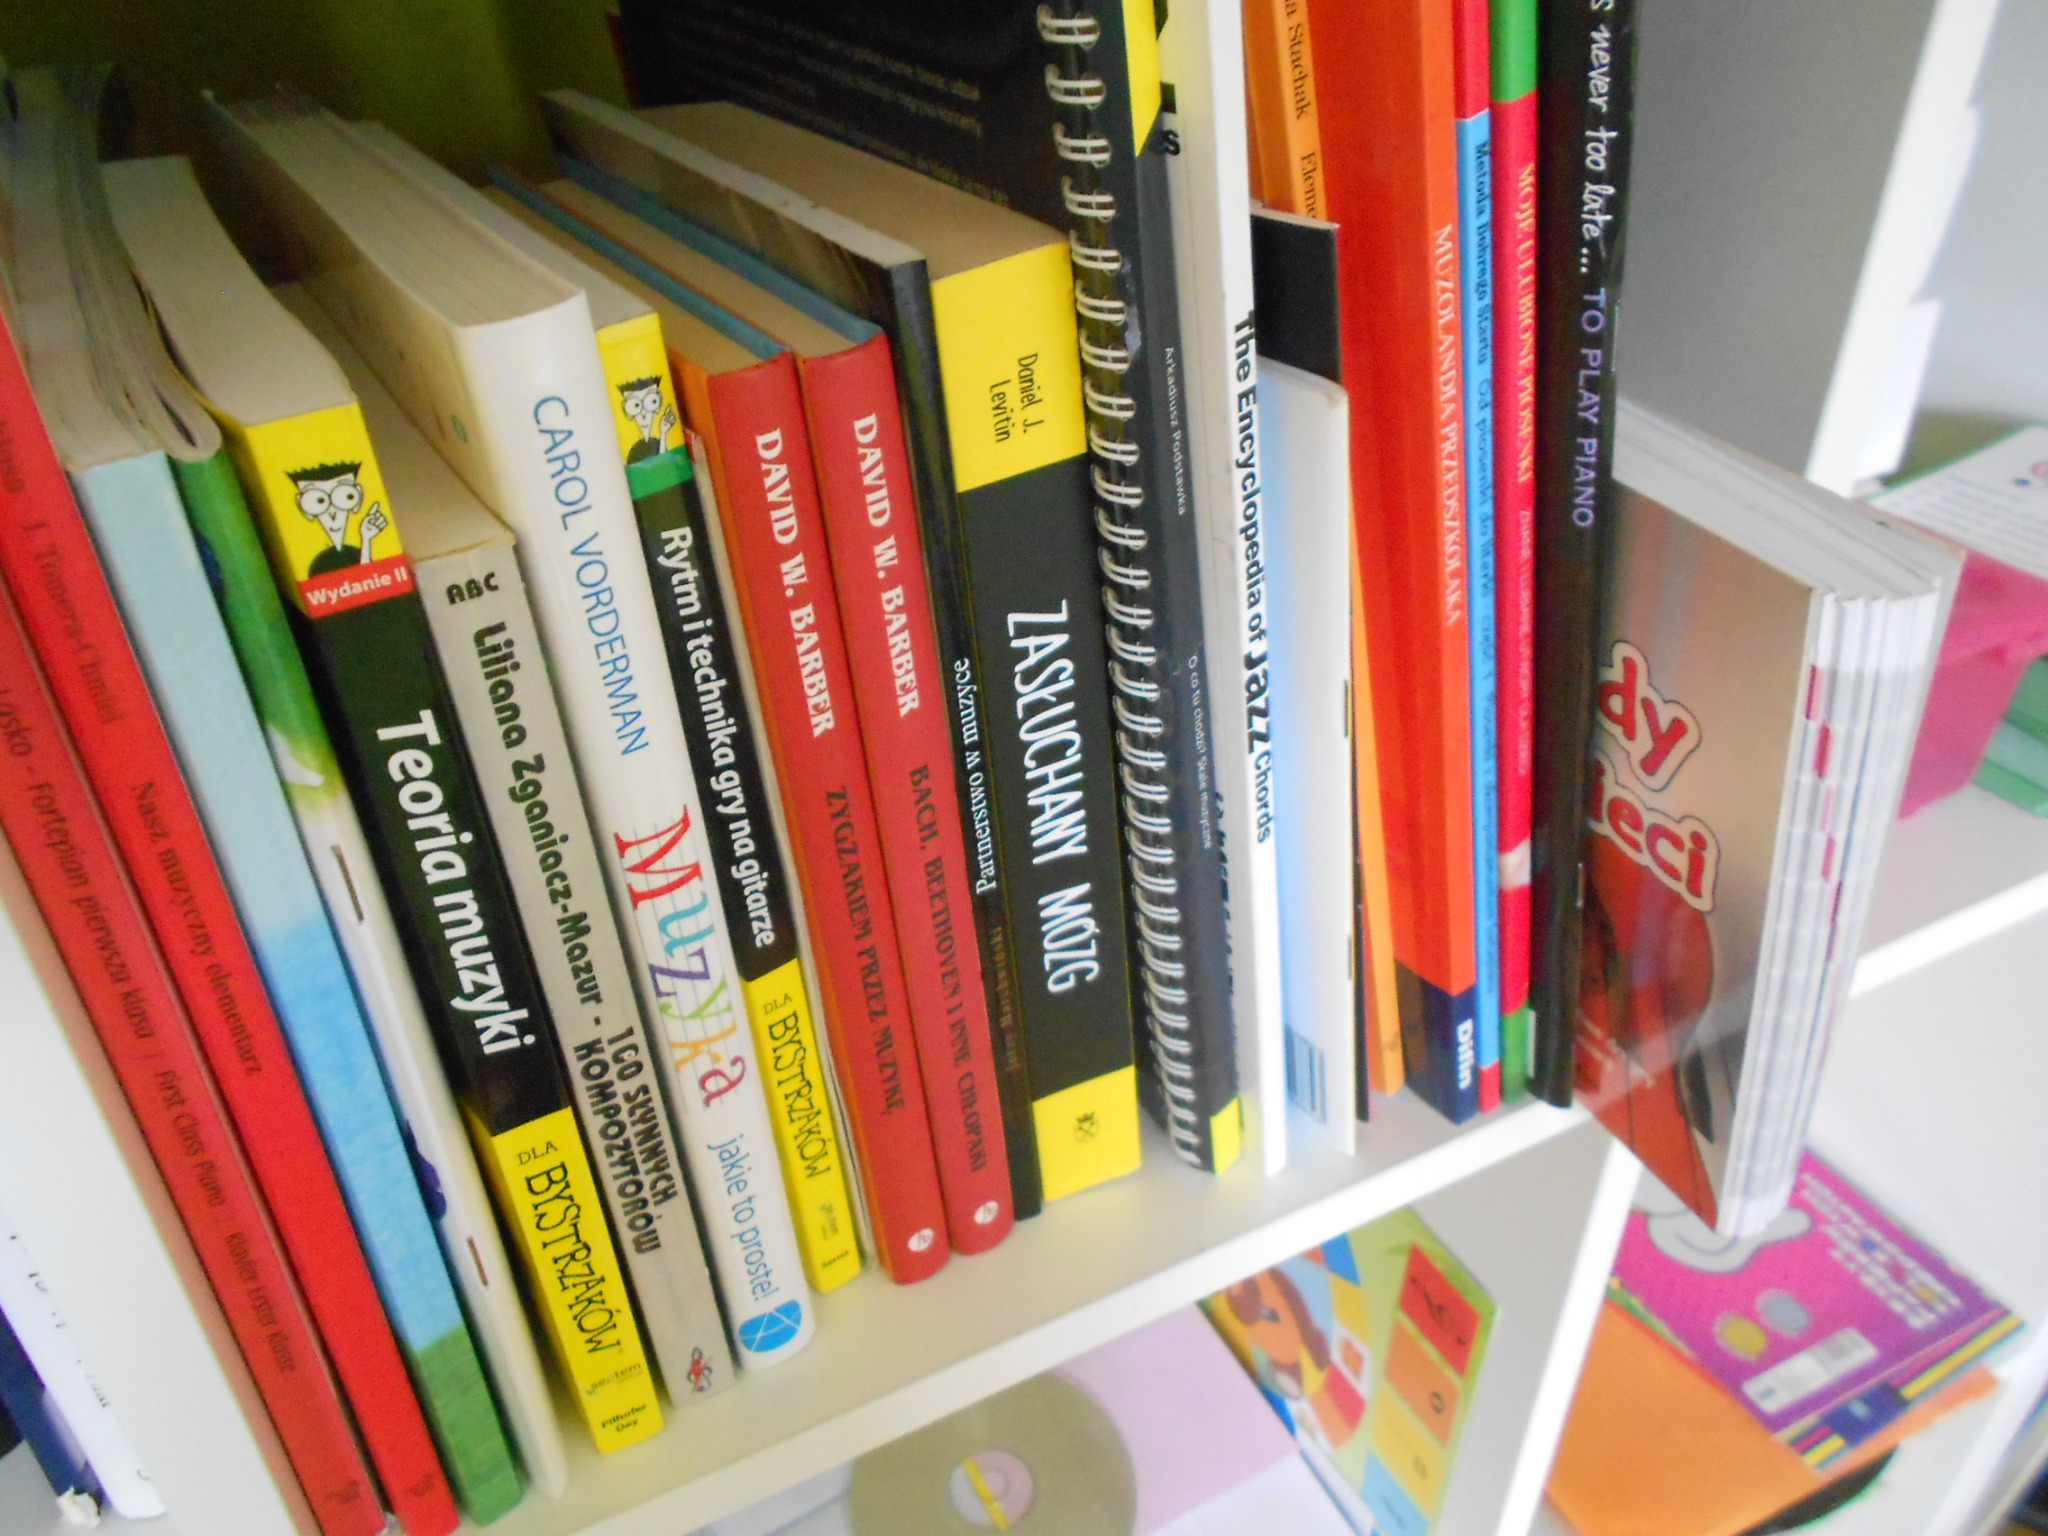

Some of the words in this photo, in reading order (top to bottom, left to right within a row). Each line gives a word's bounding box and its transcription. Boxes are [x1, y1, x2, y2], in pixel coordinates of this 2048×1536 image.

[1289, 23, 1309, 119] Stachak
[1588, 24, 1611, 112] never
[1475, 140, 1490, 219] Metoda
[1585, 126, 1618, 171] too
[1515, 164, 1534, 233] MOJE
[1474, 221, 1490, 301] Dobrego
[1517, 236, 1535, 371] ULUBIONE
[1234, 311, 1258, 382] The
[1435, 225, 1456, 420] MUZOLANDIA
[1581, 287, 1606, 332] TO
[990, 380, 1014, 442] Levitin
[1018, 353, 1042, 410] Daniel
[1578, 349, 1602, 424] PLAY
[1023, 419, 1044, 433] J.
[1165, 347, 1178, 427] Arkadiusz
[1173, 430, 1186, 515] Podstawka
[1517, 373, 1535, 484] PIOSENKI
[757, 428, 797, 544] DAVID
[854, 414, 890, 527] DAVID
[1236, 387, 1264, 609] Encyclopedia
[1573, 438, 1597, 527] PIANO
[874, 535, 897, 578] W.
[1441, 422, 1461, 625] PRZEDSZKOLAKA
[306, 571, 390, 607] Wydanie
[446, 572, 499, 605] ABC
[534, 396, 592, 531] CAROL
[571, 532, 649, 755] VORDERMAN
[657, 527, 701, 616] Rytm
[781, 553, 807, 597] W.
[683, 619, 712, 631] i
[882, 585, 919, 716] BARBER
[1189, 656, 1197, 668] O
[1249, 613, 1267, 642] of
[687, 634, 737, 767] technika
[790, 603, 834, 737] BARBER
[954, 658, 978, 745] muzyce
[1191, 672, 1198, 688] co
[1244, 652, 1271, 757] Jazz
[966, 751, 980, 769] w
[1007, 599, 1087, 864] ZASŁUCHANY
[1198, 756, 1208, 790] Skale
[474, 622, 526, 749] Liliana
[509, 754, 603, 1004] Zganiacz-Mazur
[594, 1017, 600, 1025] -
[710, 770, 746, 814] gry
[910, 765, 939, 850] BACH,
[969, 772, 996, 894] Partnerstwo
[1200, 792, 1211, 849] muzyczne
[1255, 753, 1274, 843] Chords
[377, 709, 472, 884] Teoria
[433, 890, 535, 1054] muzyki
[729, 819, 755, 856] na
[131, 782, 169, 843] Nasz
[158, 848, 214, 956] muzyczny
[205, 964, 262, 1076] elementarz
[731, 859, 775, 947] gitarze
[925, 857, 960, 998] BEETHOVEN
[1038, 883, 1100, 992] MÓZG
[27, 782, 90, 888] Fortepian
[70, 894, 131, 983] pierwsza
[120, 989, 155, 1039] klasa
[156, 1070, 187, 1110] First
[173, 1113, 205, 1157] Class
[194, 1160, 225, 1207] Piano
[614, 804, 746, 1106] Muzyka
[826, 788, 872, 940] ZYGZAKIEM
[858, 946, 887, 1018] PRZEZ
[875, 1026, 904, 1114] MUZYKĘ
[763, 994, 792, 1015] DLA
[947, 1003, 963, 1015] I
[950, 1018, 971, 1067] INNE
[768, 1010, 833, 1178] BYSTRZAKÓW
[958, 1072, 986, 1172] CHŁOPAKI
[517, 1140, 558, 1165] DLA
[574, 1038, 661, 1253] KOMPOZYTORÓW
[623, 1084, 677, 1206] SŁYNNYCH
[707, 1134, 751, 1195] jakie
[732, 1196, 755, 1223] to
[525, 1162, 619, 1353] BYSTRZAKÓW
[730, 1226, 779, 1301] proste!
